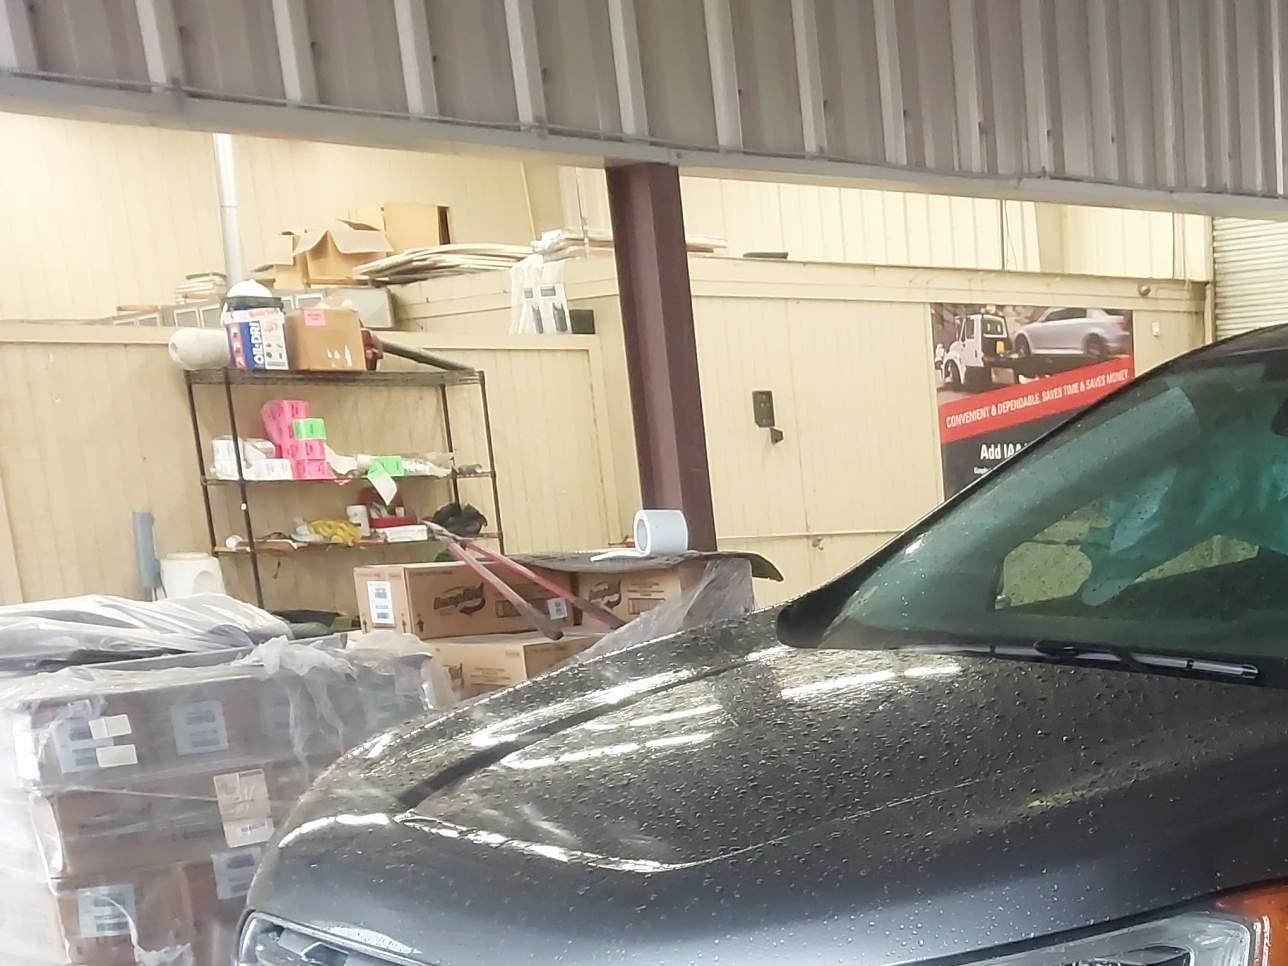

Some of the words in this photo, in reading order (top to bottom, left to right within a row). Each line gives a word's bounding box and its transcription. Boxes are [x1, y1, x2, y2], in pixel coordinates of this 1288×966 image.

[946, 406, 990, 428] CONVENIENT
[991, 405, 997, 417] &
[1042, 386, 1062, 402] SAVES
[1080, 380, 1085, 393] &
[1086, 375, 1105, 390] SAVES
[980, 443, 1002, 460] Add
